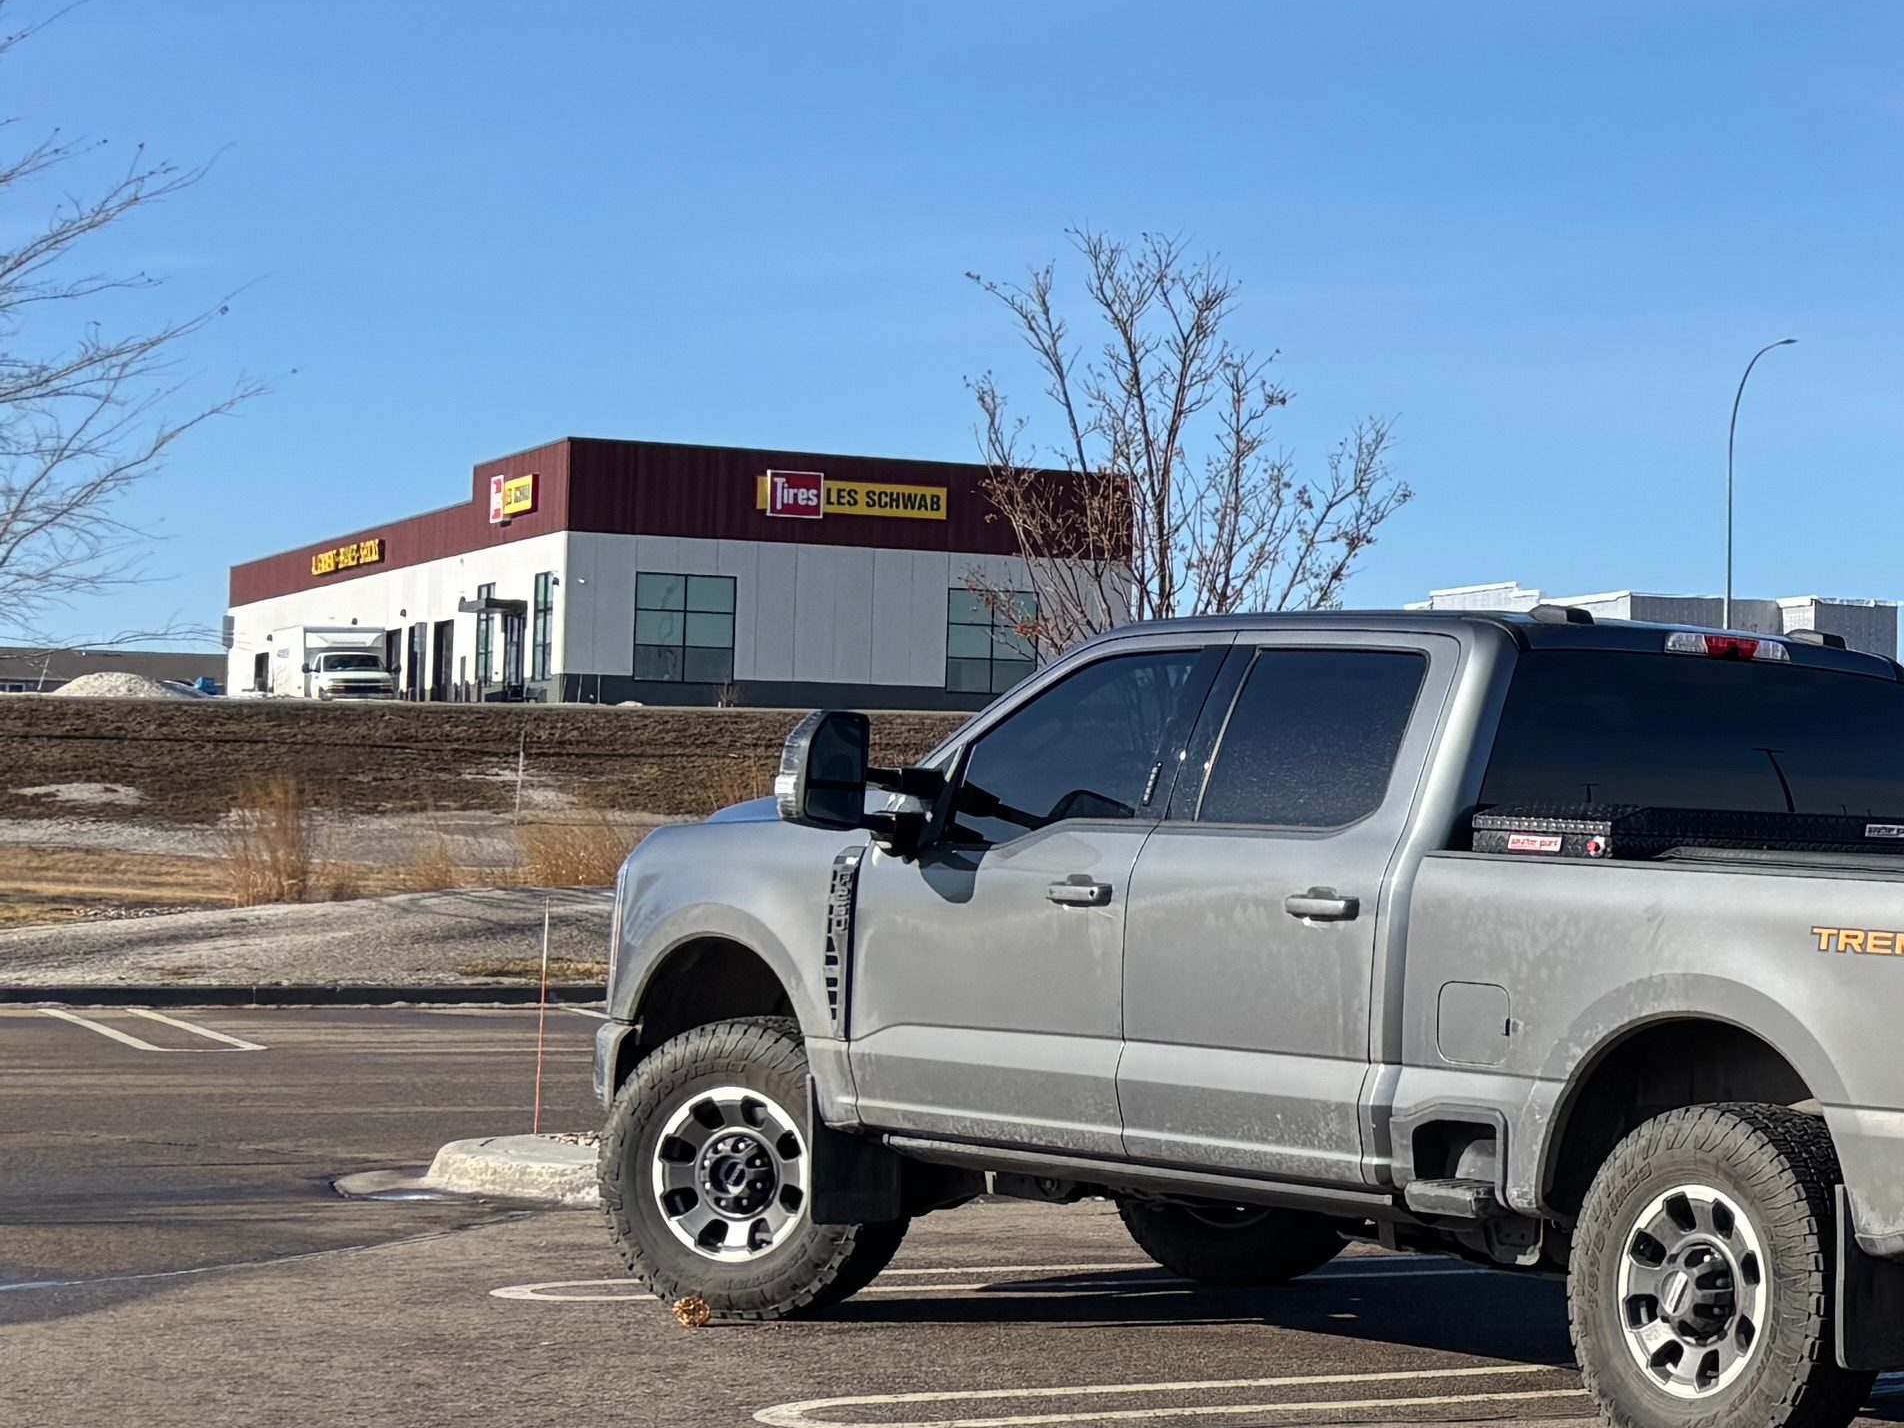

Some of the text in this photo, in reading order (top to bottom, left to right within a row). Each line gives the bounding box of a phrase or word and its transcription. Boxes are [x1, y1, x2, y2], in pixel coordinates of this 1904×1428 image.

[773, 477, 818, 510] Tires
[826, 487, 941, 512] LES SCHWAB
